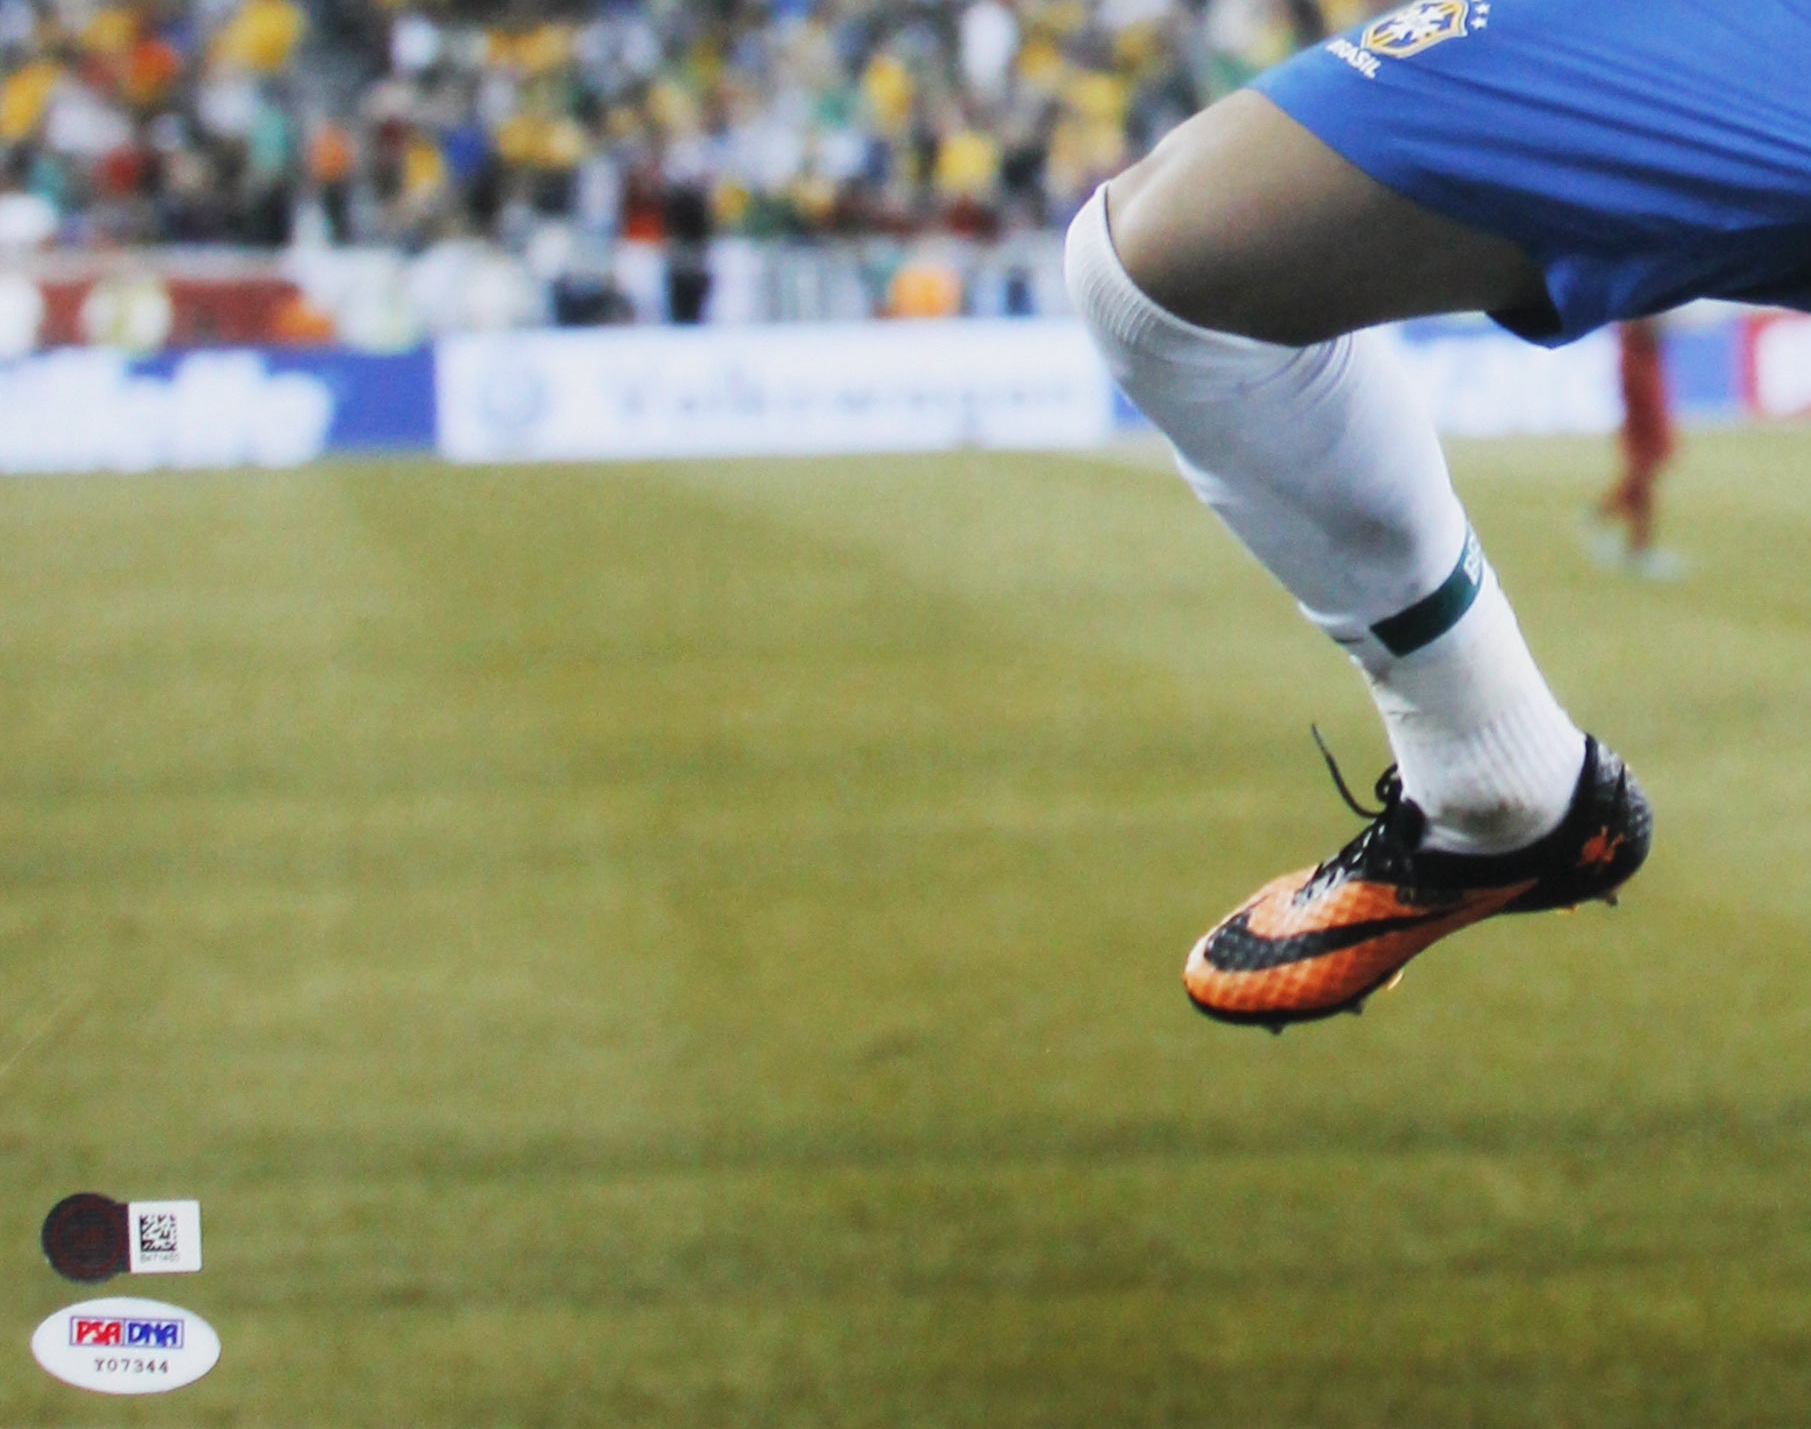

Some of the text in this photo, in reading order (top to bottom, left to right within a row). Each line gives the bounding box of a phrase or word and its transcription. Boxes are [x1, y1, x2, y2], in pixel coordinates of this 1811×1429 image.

[76, 1321, 178, 1347] PSA DNA
[94, 1357, 169, 1374] Y07344
